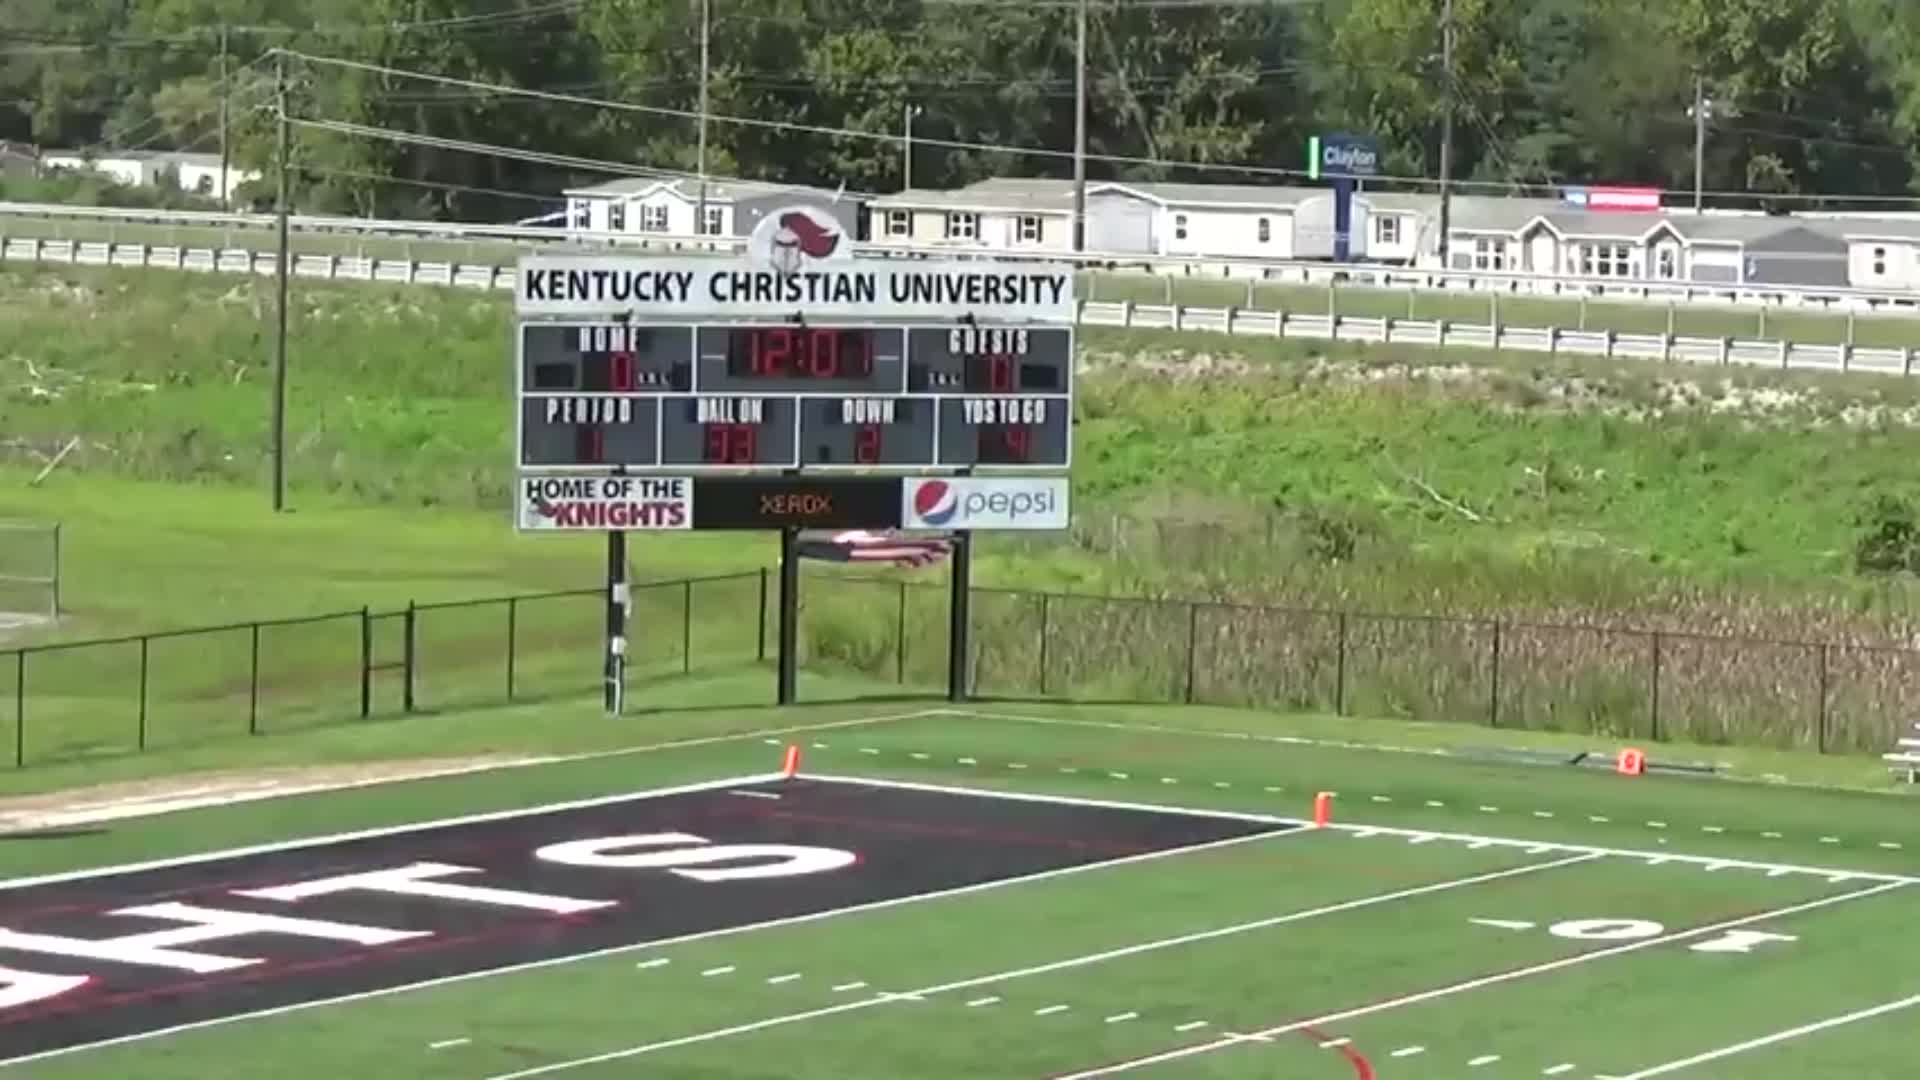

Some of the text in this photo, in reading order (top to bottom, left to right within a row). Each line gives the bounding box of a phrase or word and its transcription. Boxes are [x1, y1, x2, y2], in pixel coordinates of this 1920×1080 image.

[526, 270, 1066, 304] KENTUCKY CHRISTIAN UNIVERSITY
[579, 327, 638, 352] HOME
[950, 329, 1028, 354] GUESTS
[547, 398, 630, 424] PERIOD
[697, 398, 763, 424] BALL ON
[843, 398, 895, 424] DOWN
[963, 399, 995, 425] YDS
[526, 479, 685, 499] HOME OF THE
[555, 501, 686, 527] KNIGHTS
[964, 488, 1056, 518] pepsi
